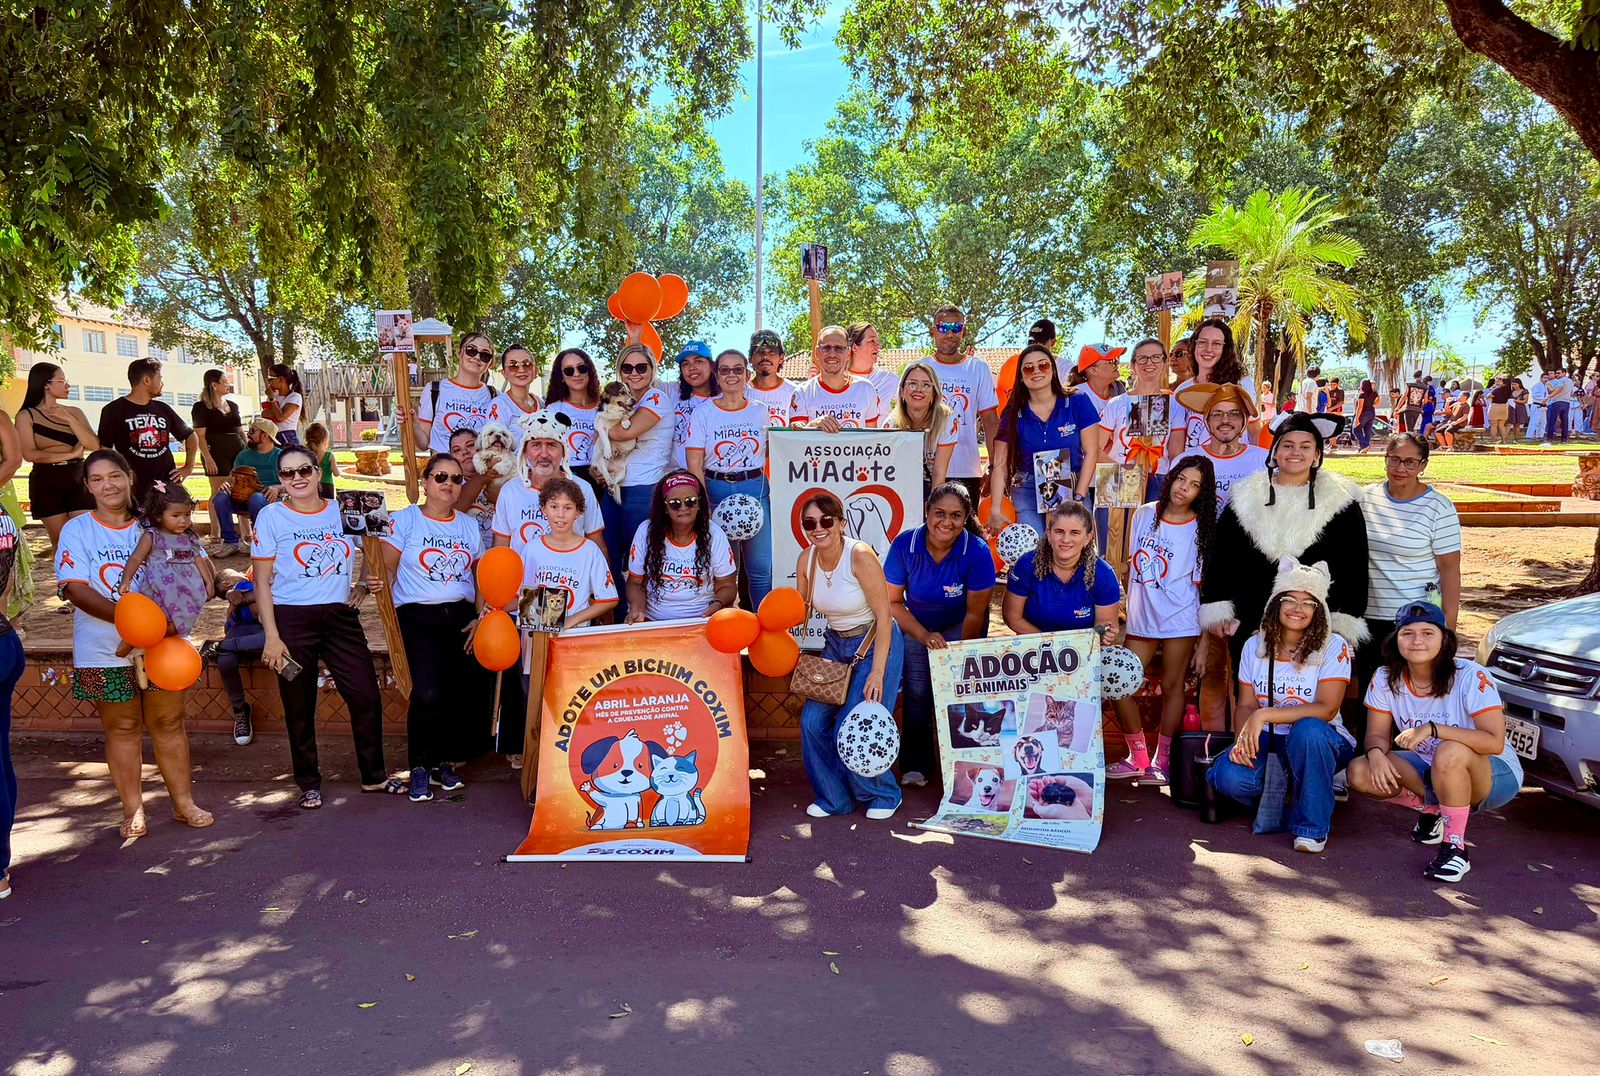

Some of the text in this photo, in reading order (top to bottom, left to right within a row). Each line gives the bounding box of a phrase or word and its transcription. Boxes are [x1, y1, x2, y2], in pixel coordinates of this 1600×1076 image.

[125, 416, 167, 430] TEXAS
[714, 427, 760, 440] MiAdote
[804, 443, 891, 460] ASSOCIAÇÃO
[788, 458, 896, 483] MiAdote
[422, 536, 470, 550] MiAdote
[97, 549, 131, 561] MiAd
[539, 565, 578, 575] ASSOCIAÇÃO
[962, 643, 1080, 682] ADOÇÃO
[956, 679, 1027, 695] DE ANIMAIS
[555, 658, 733, 752] ADOTE UM BICHIM COXIM
[594, 692, 690, 711] ABRIL LARANJA
[595, 710, 609, 718] MÊS
[620, 705, 660, 716] PREVENÇÃO
[661, 704, 689, 713] CONTRA
[613, 714, 653, 723] CRUELDADE
[653, 712, 680, 720] ANIMAL
